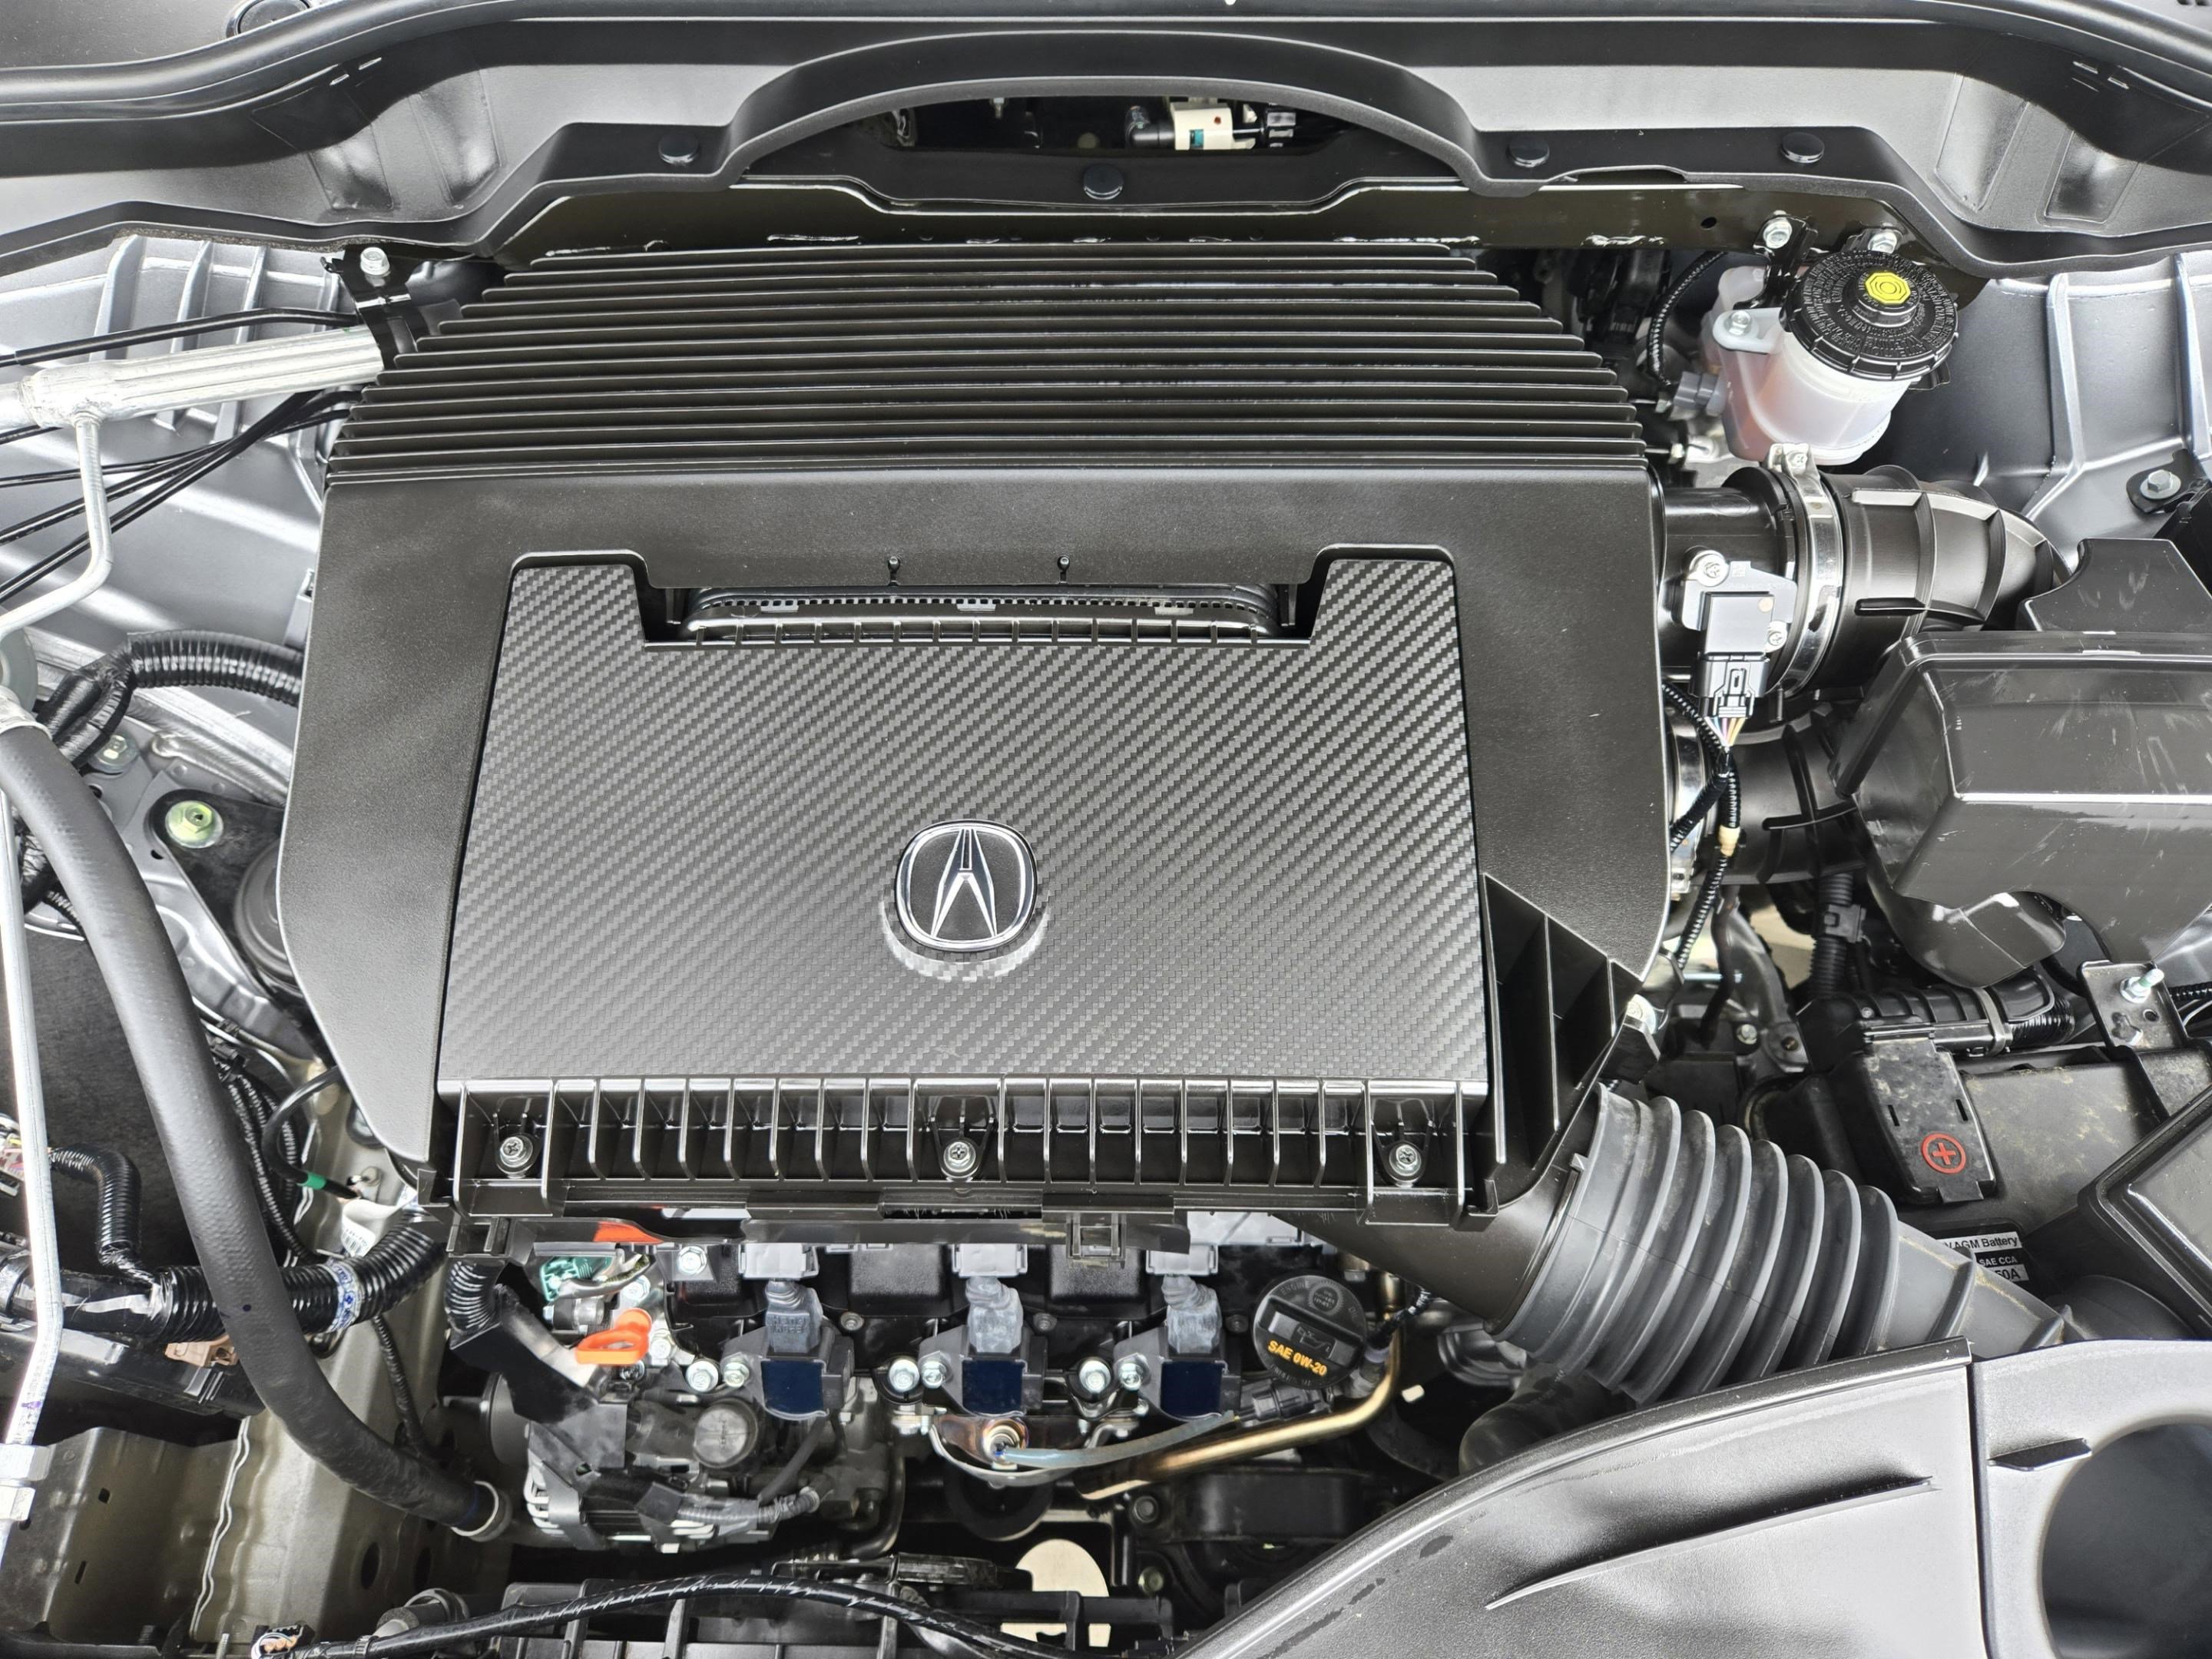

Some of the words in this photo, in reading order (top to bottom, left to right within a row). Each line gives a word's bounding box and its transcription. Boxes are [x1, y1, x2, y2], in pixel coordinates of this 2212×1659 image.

[1981, 1237, 2018, 1248] Battery
[1979, 1258, 1998, 1267] SAE
[1998, 1256, 2018, 1265] CCA
[1268, 1340, 1292, 1359] SAE
[1293, 1352, 1327, 1376] 0W-20
